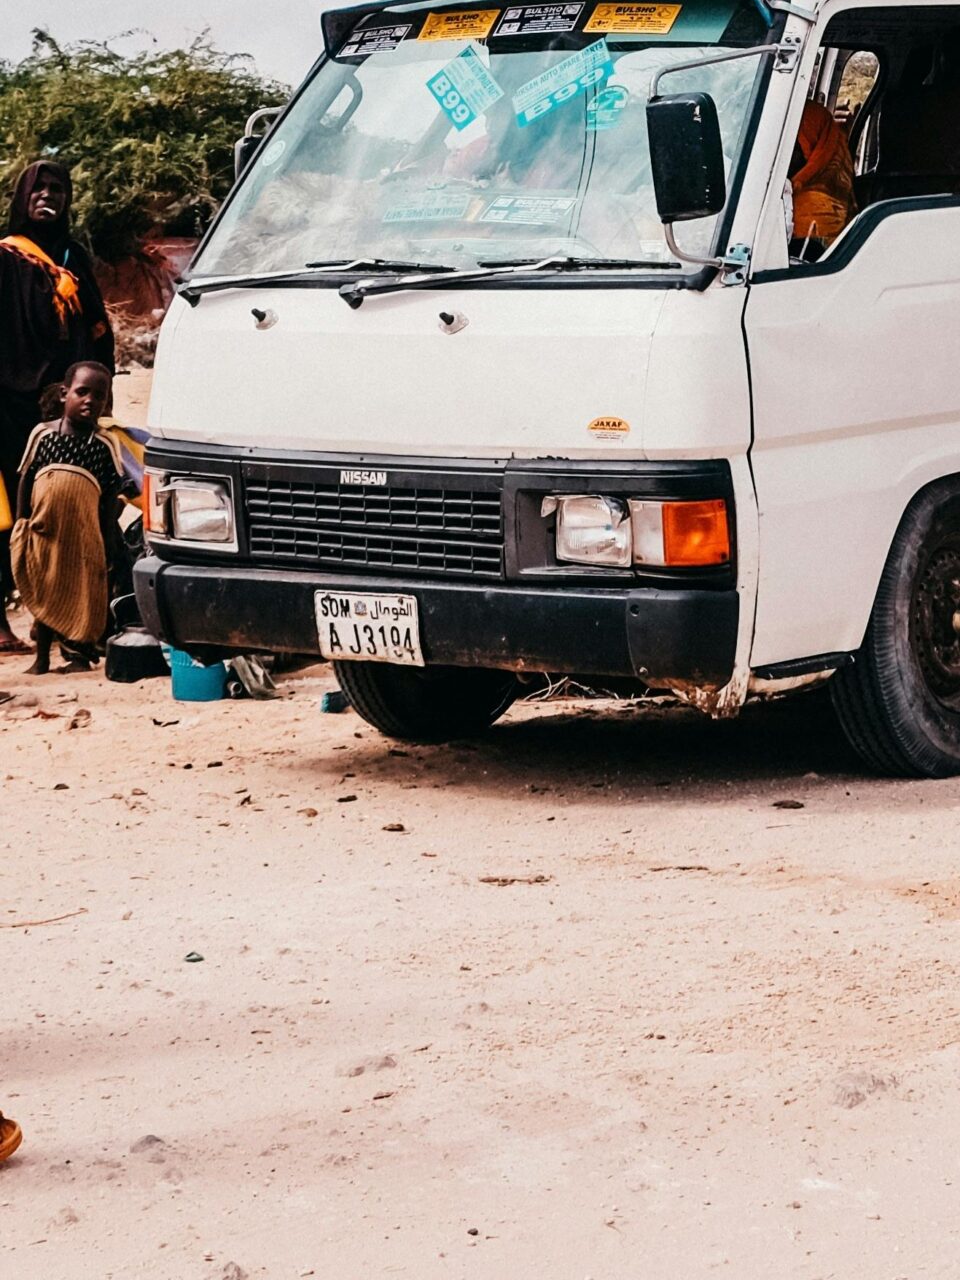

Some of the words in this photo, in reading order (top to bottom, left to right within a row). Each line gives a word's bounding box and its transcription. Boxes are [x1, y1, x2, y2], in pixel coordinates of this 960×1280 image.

[525, 6, 563, 15] BULSHO
[615, 6, 656, 14] BULSHO
[430, 75, 473, 124] B99
[522, 68, 606, 121] B99
[340, 470, 387, 485] NISSAN
[321, 597, 350, 618] SOM
